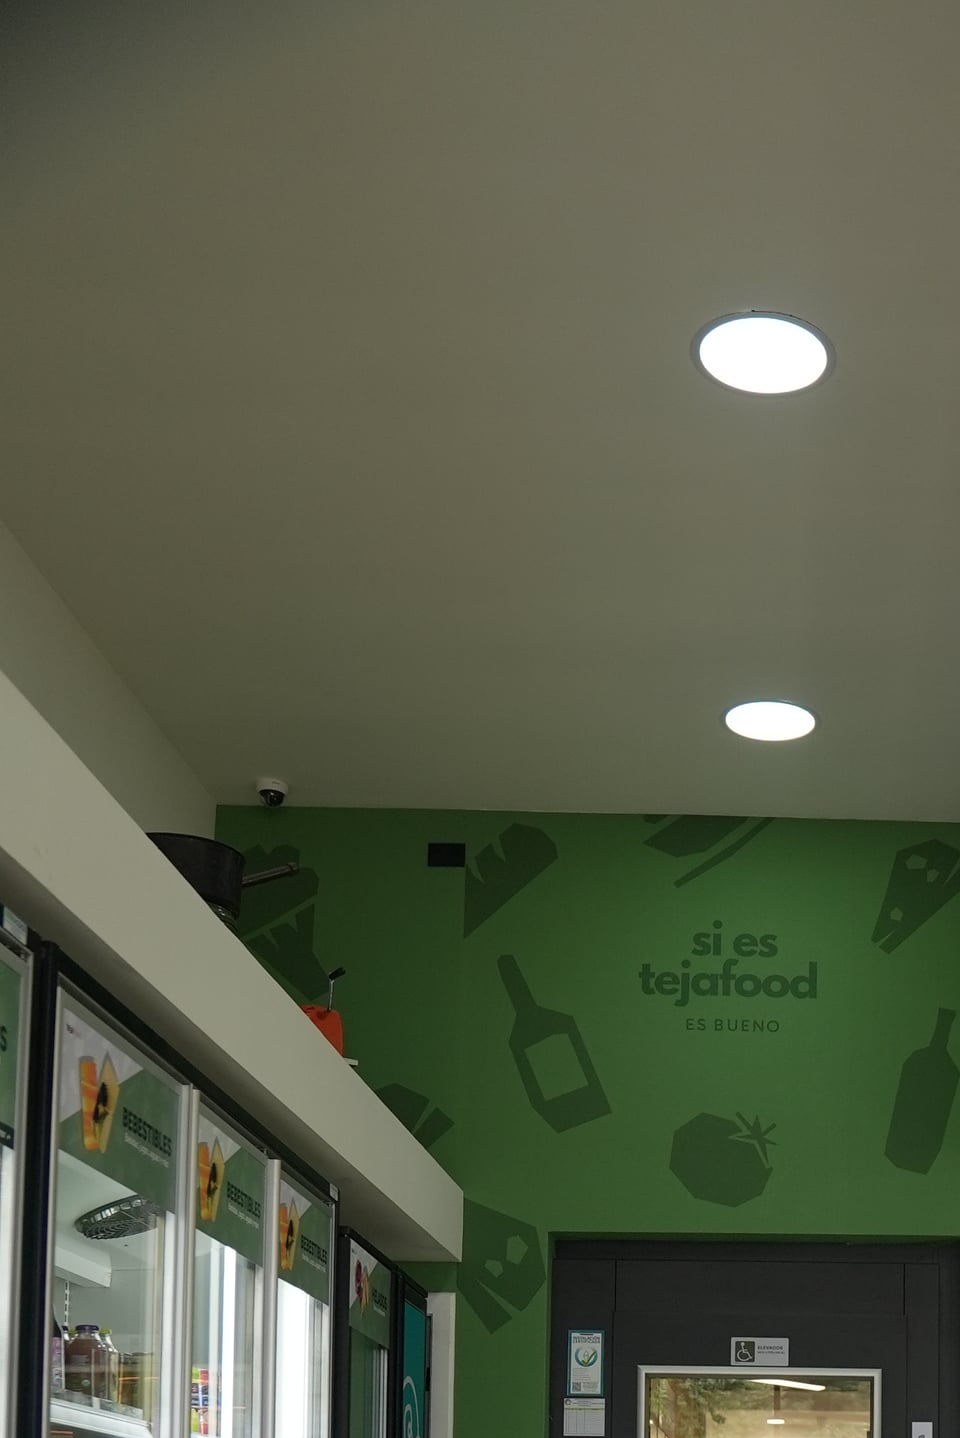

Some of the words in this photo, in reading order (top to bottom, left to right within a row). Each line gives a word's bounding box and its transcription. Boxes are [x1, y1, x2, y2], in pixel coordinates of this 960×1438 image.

[691, 919, 723, 956] si
[732, 933, 779, 958] es
[638, 958, 818, 1007] tejafood
[685, 1018, 707, 1031] ES
[714, 1018, 781, 1033] BUENO
[122, 1106, 173, 1158] BEBESTIBLES
[226, 1180, 261, 1219] BEBESTIBLES
